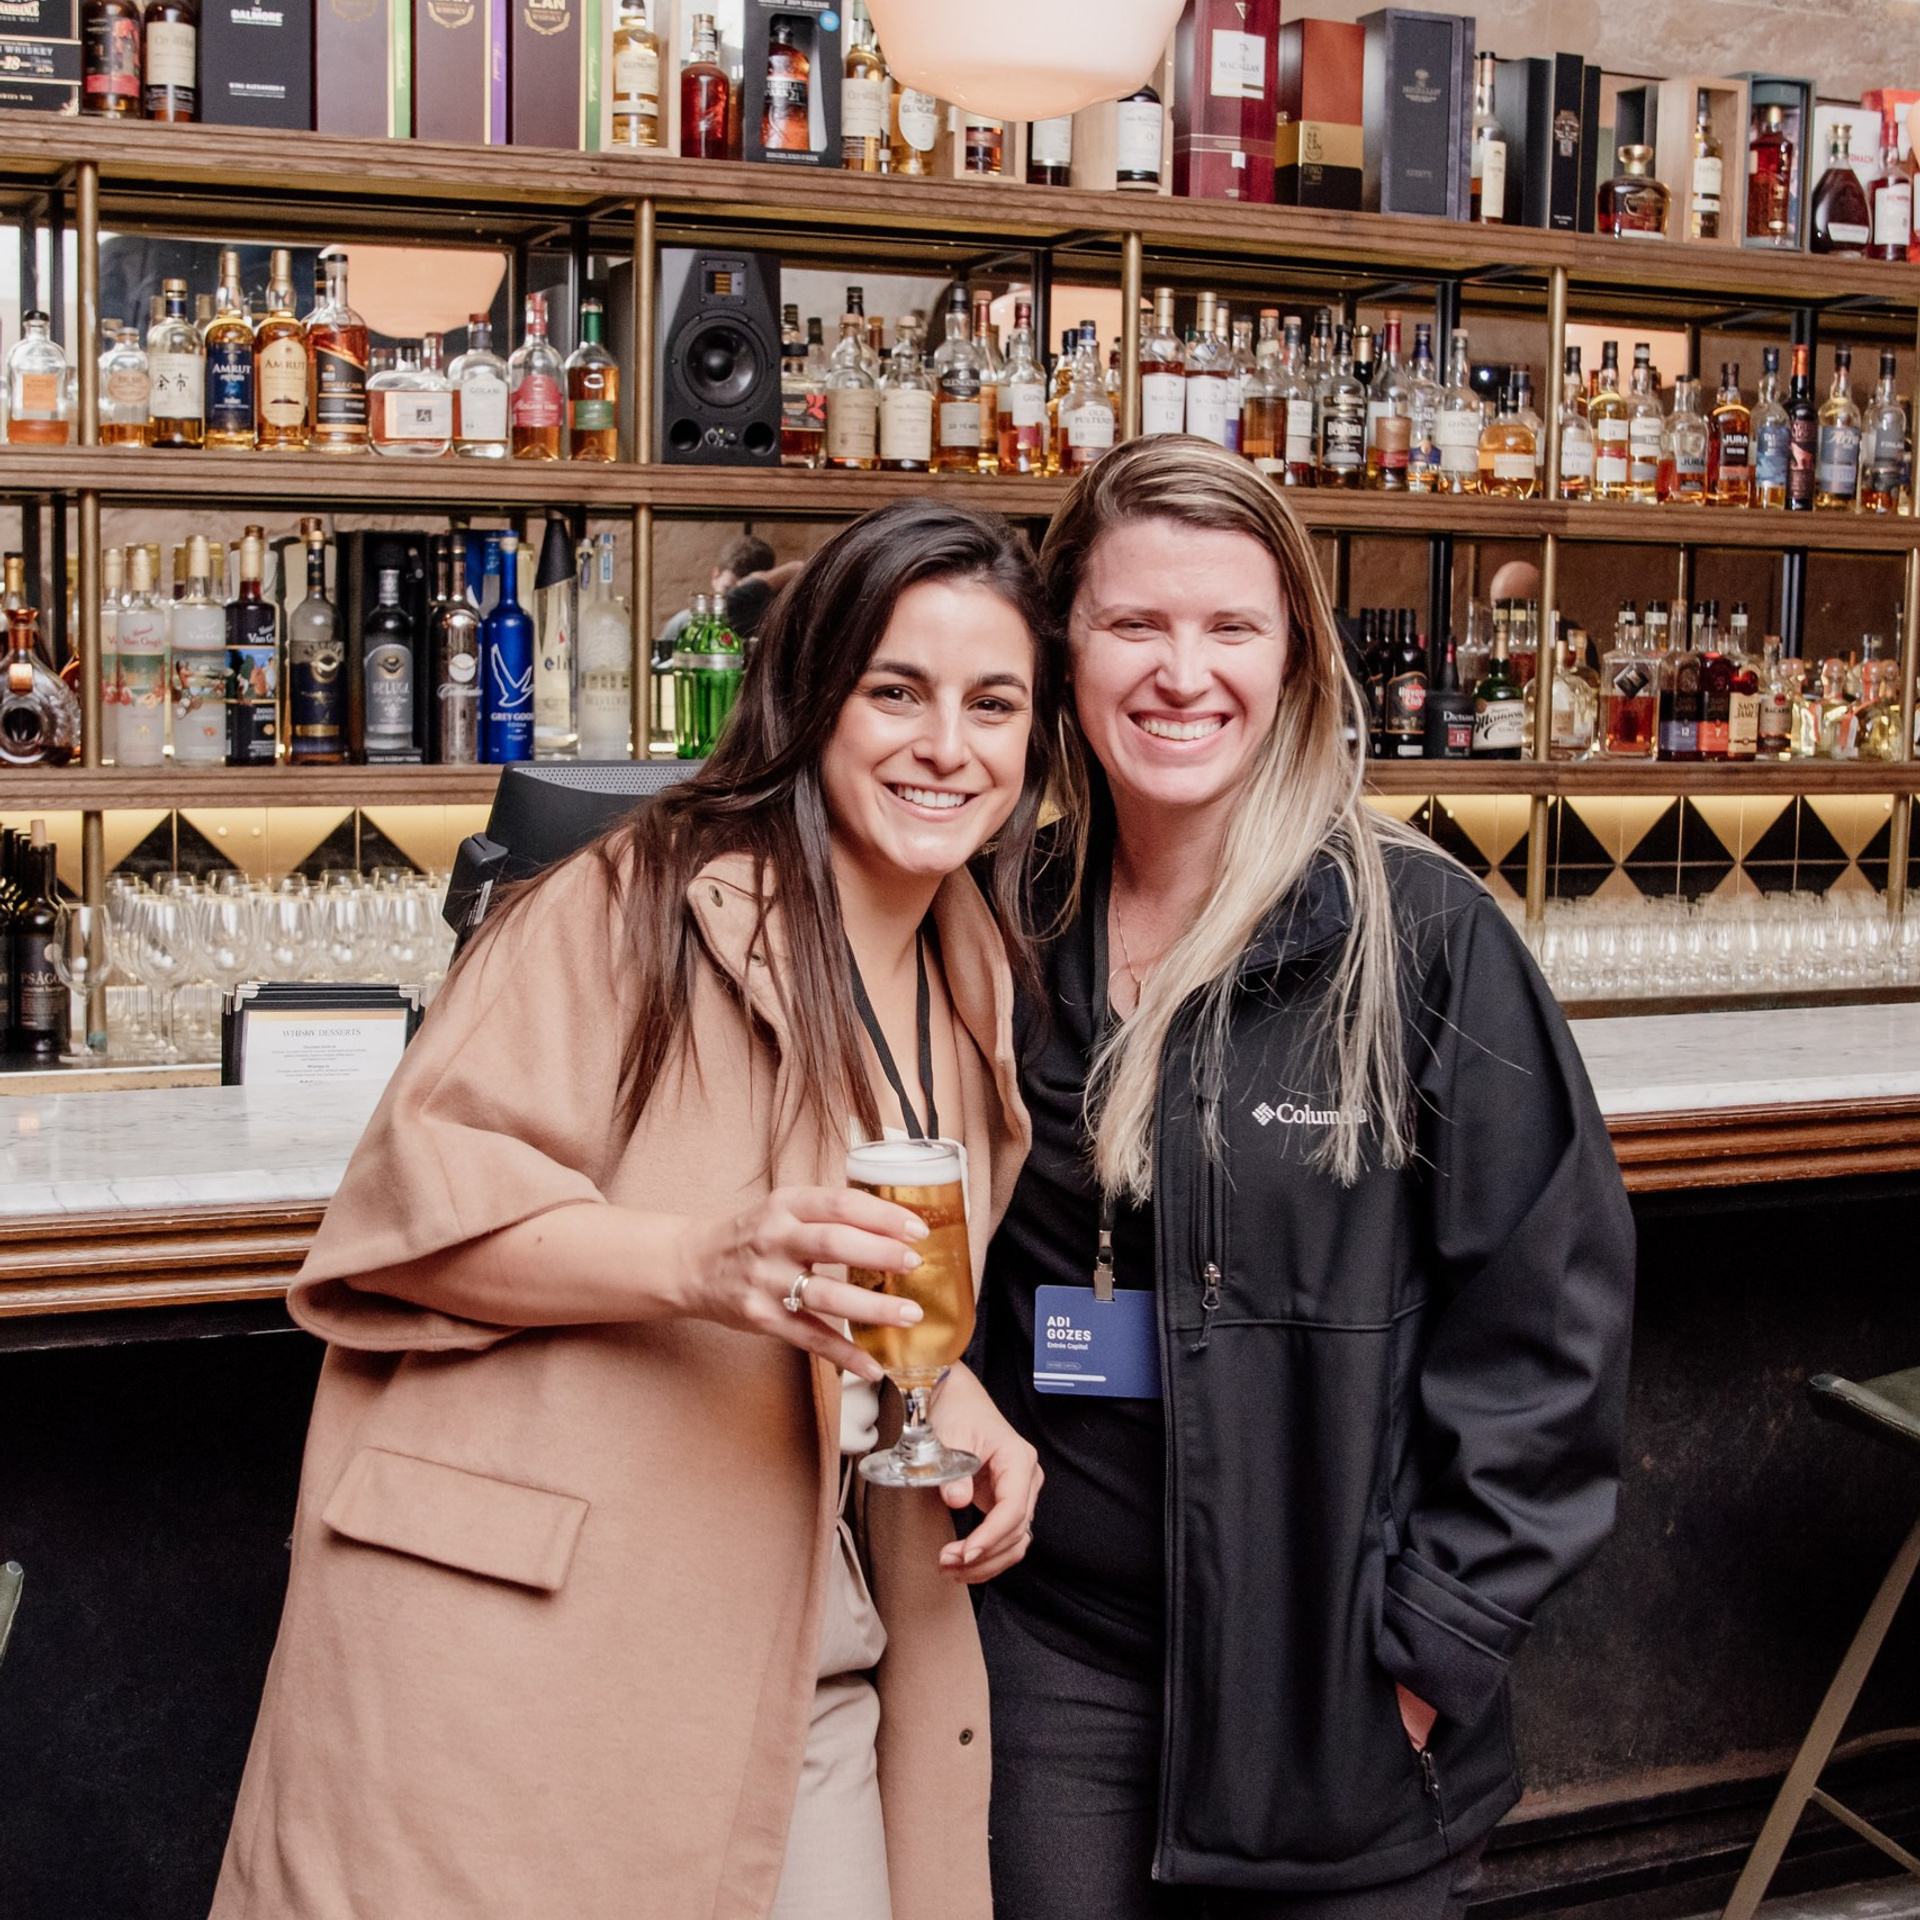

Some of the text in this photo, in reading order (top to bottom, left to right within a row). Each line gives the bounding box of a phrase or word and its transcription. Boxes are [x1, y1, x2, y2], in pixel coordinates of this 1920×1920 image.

[230, 9, 284, 22] DALMORE
[4, 46, 54, 56] WHISKEY
[212, 364, 252, 374] AMRUT
[264, 359, 305, 371] AMRUT
[1723, 434, 1748, 444] JURA
[1680, 458, 1705, 467] JURA
[123, 636, 139, 645] Van
[247, 632, 265, 643] Van
[491, 712, 513, 722] GREY
[1681, 728, 1690, 736] 12
[318, 1028, 361, 1037] DESSERTS
[1276, 1103, 1368, 1125] Columa
[1047, 1316, 1070, 1328] ADI
[1047, 1329, 1092, 1341] GOZES
[1067, 1342, 1089, 1351] Capital
